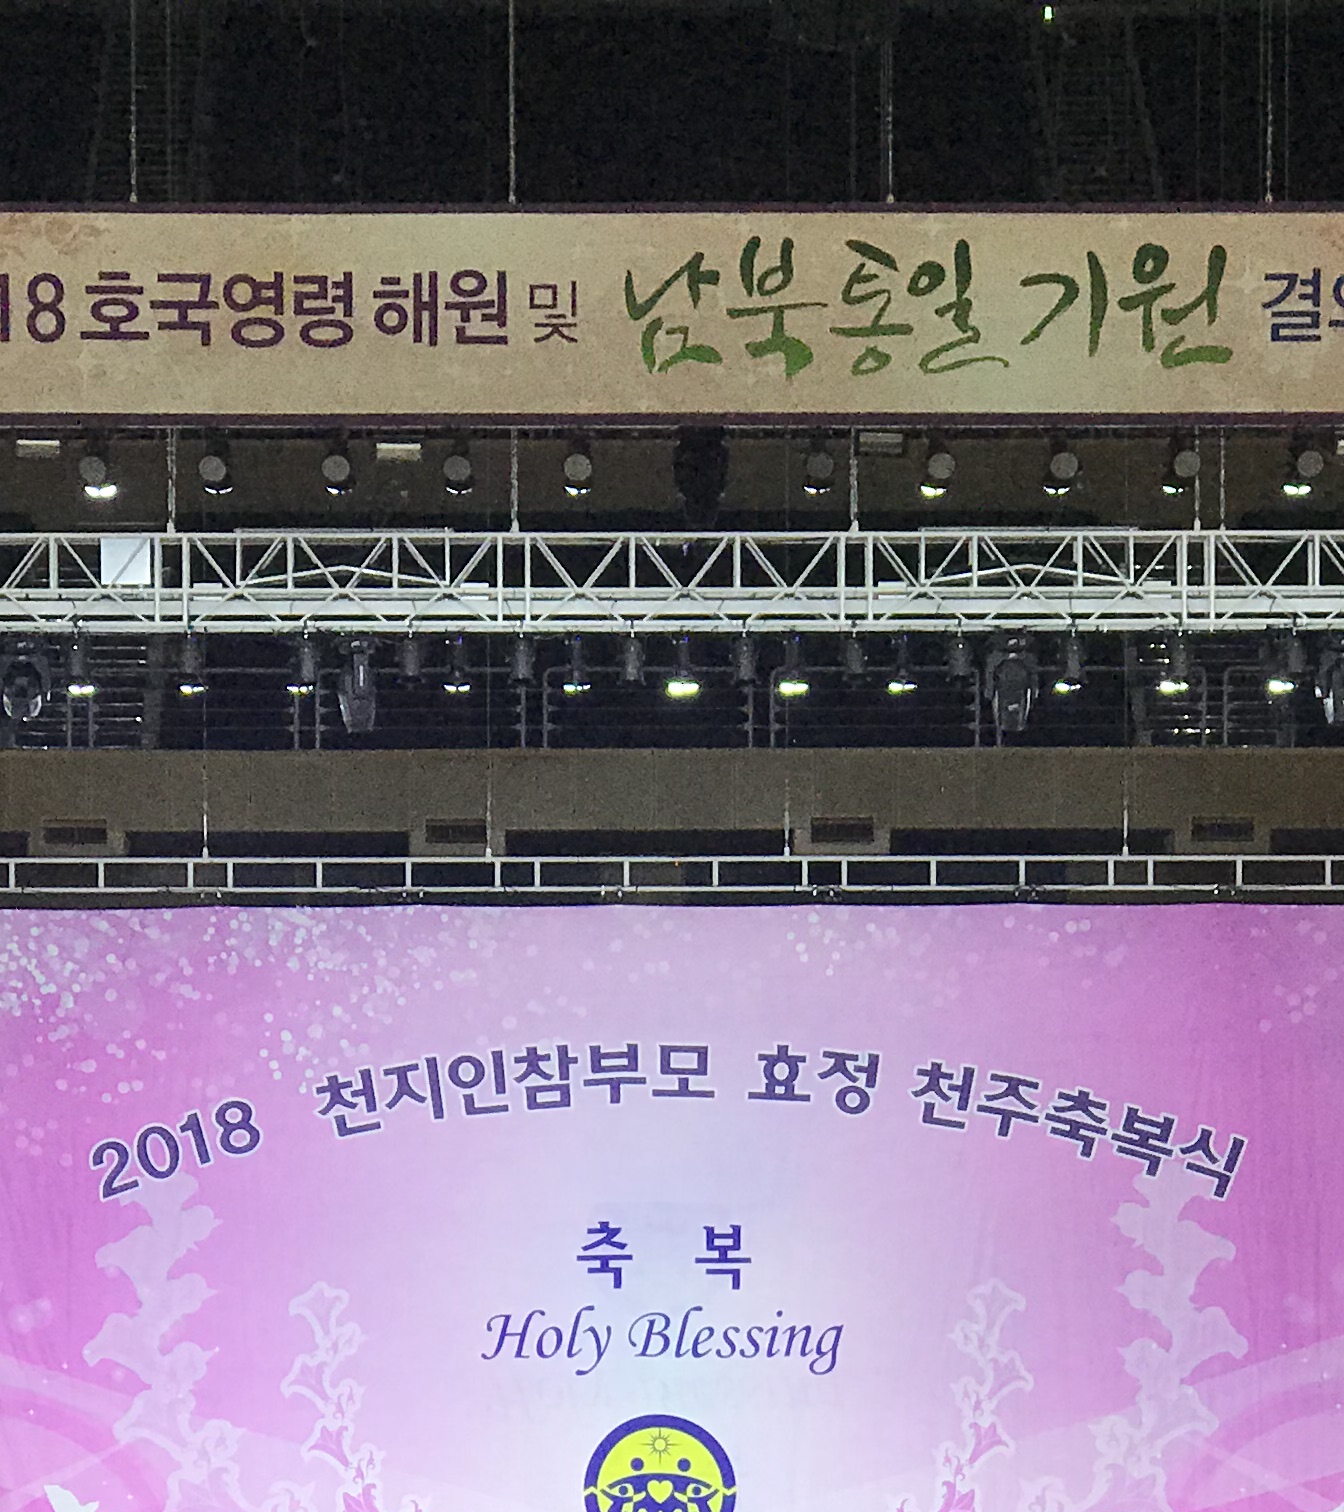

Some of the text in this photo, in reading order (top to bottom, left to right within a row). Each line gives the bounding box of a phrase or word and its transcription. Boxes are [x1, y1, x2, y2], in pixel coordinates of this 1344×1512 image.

[79, 270, 354, 349] 호국영령
[372, 270, 509, 347] 해원
[528, 280, 578, 344] 및
[624, 235, 1010, 379] 남북통일
[1020, 243, 1235, 370] 기원
[91, 1043, 1246, 1199] 2018 천지인참부모 효정 천주축복식
[576, 1221, 752, 1290] 축 복
[481, 1305, 844, 1376] Holy Blessing
